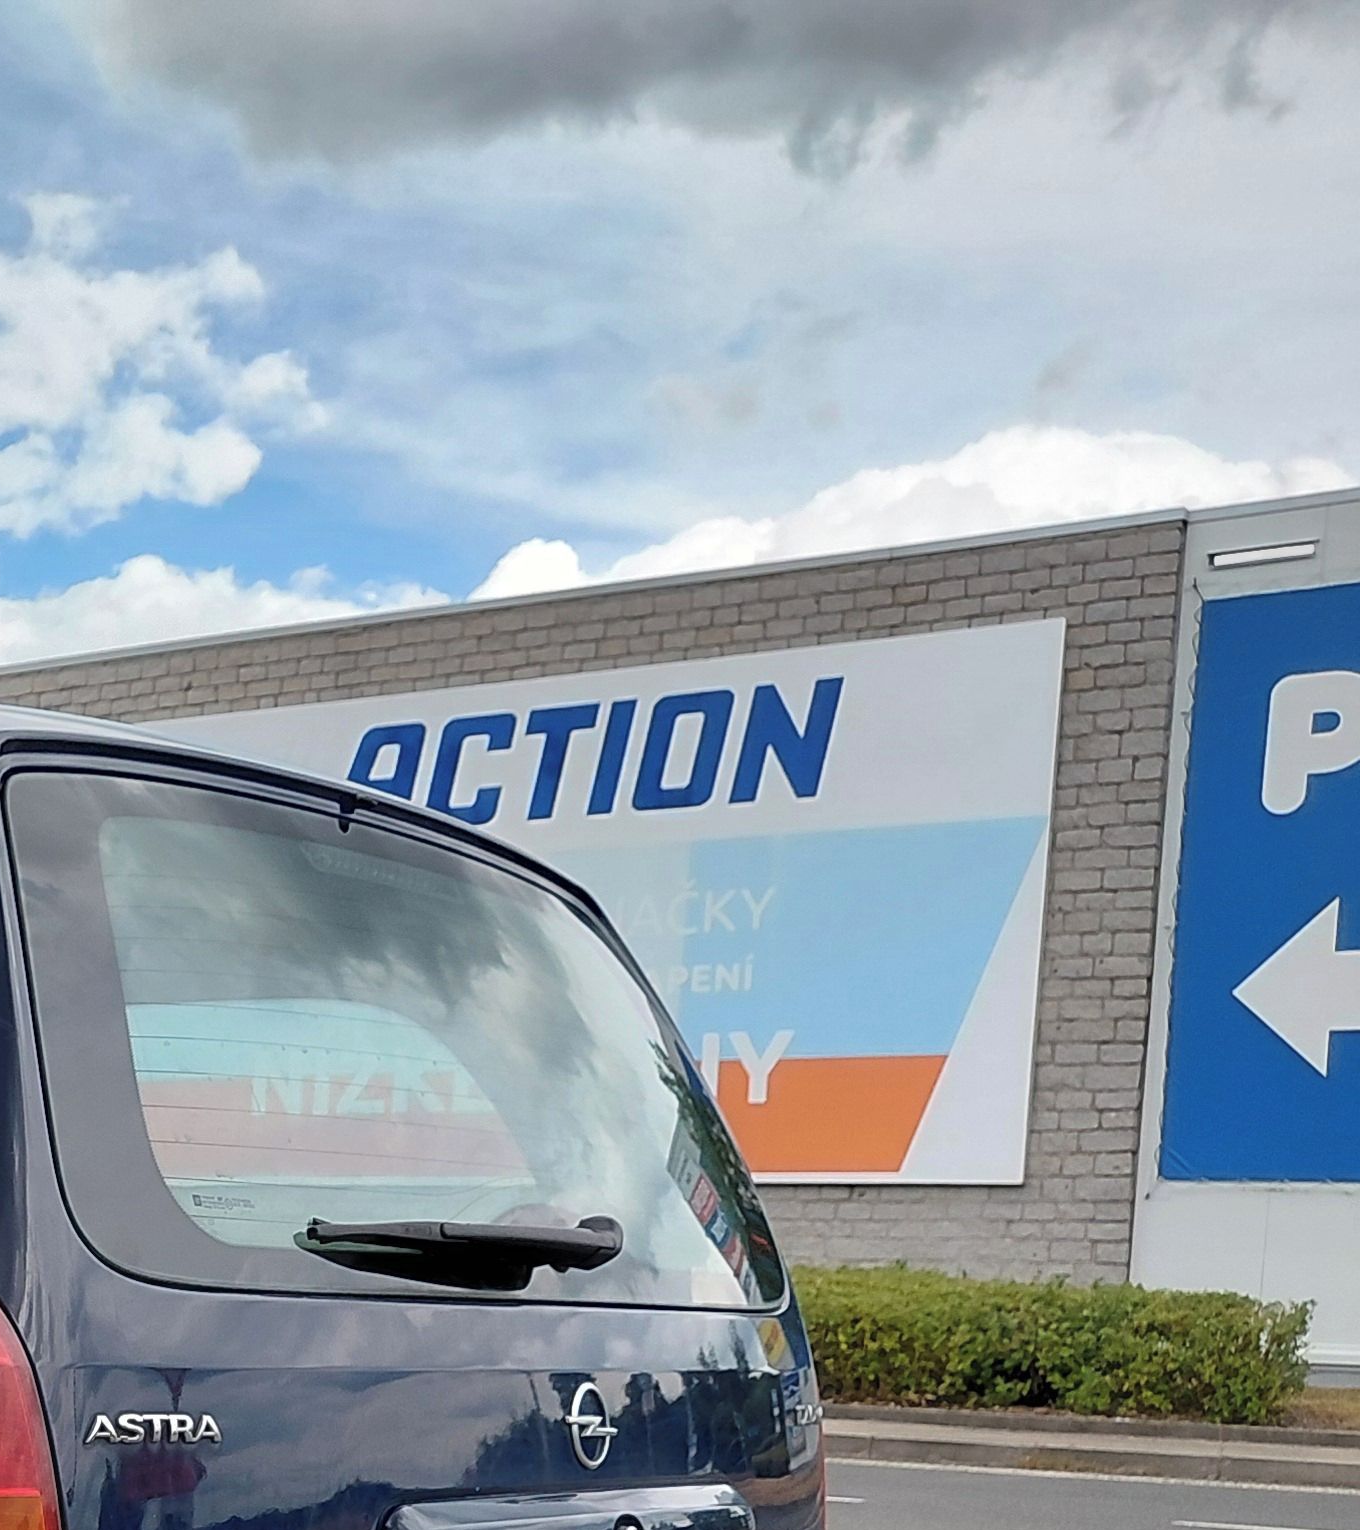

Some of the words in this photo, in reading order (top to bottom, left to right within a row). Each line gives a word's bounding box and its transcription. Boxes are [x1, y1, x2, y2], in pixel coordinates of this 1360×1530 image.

[347, 676, 844, 825] ACTION
[654, 953, 755, 993] PENÍ
[84, 1412, 223, 1444] ASTRA
